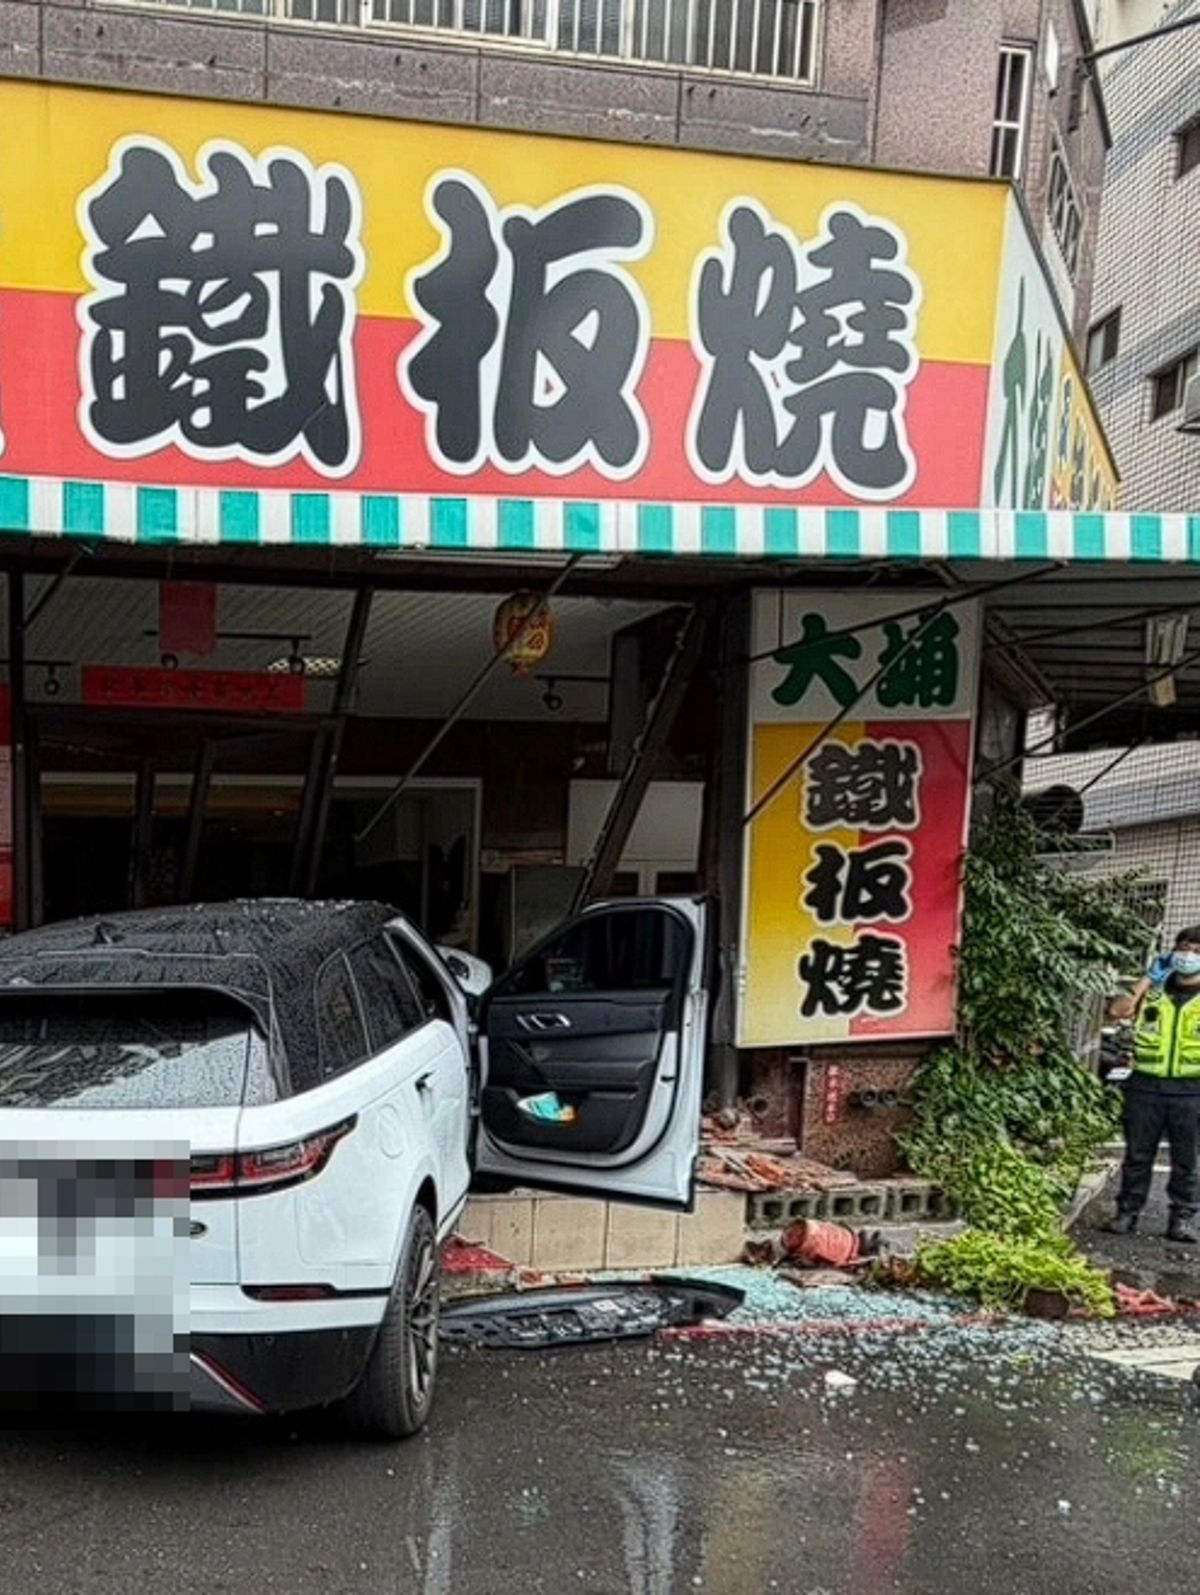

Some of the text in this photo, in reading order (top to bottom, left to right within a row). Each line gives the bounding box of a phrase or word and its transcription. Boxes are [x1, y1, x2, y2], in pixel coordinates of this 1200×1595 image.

[82, 138, 919, 496] 鐵板燒
[771, 612, 960, 708] 大埔
[799, 740, 920, 1020] 鐵板燒
